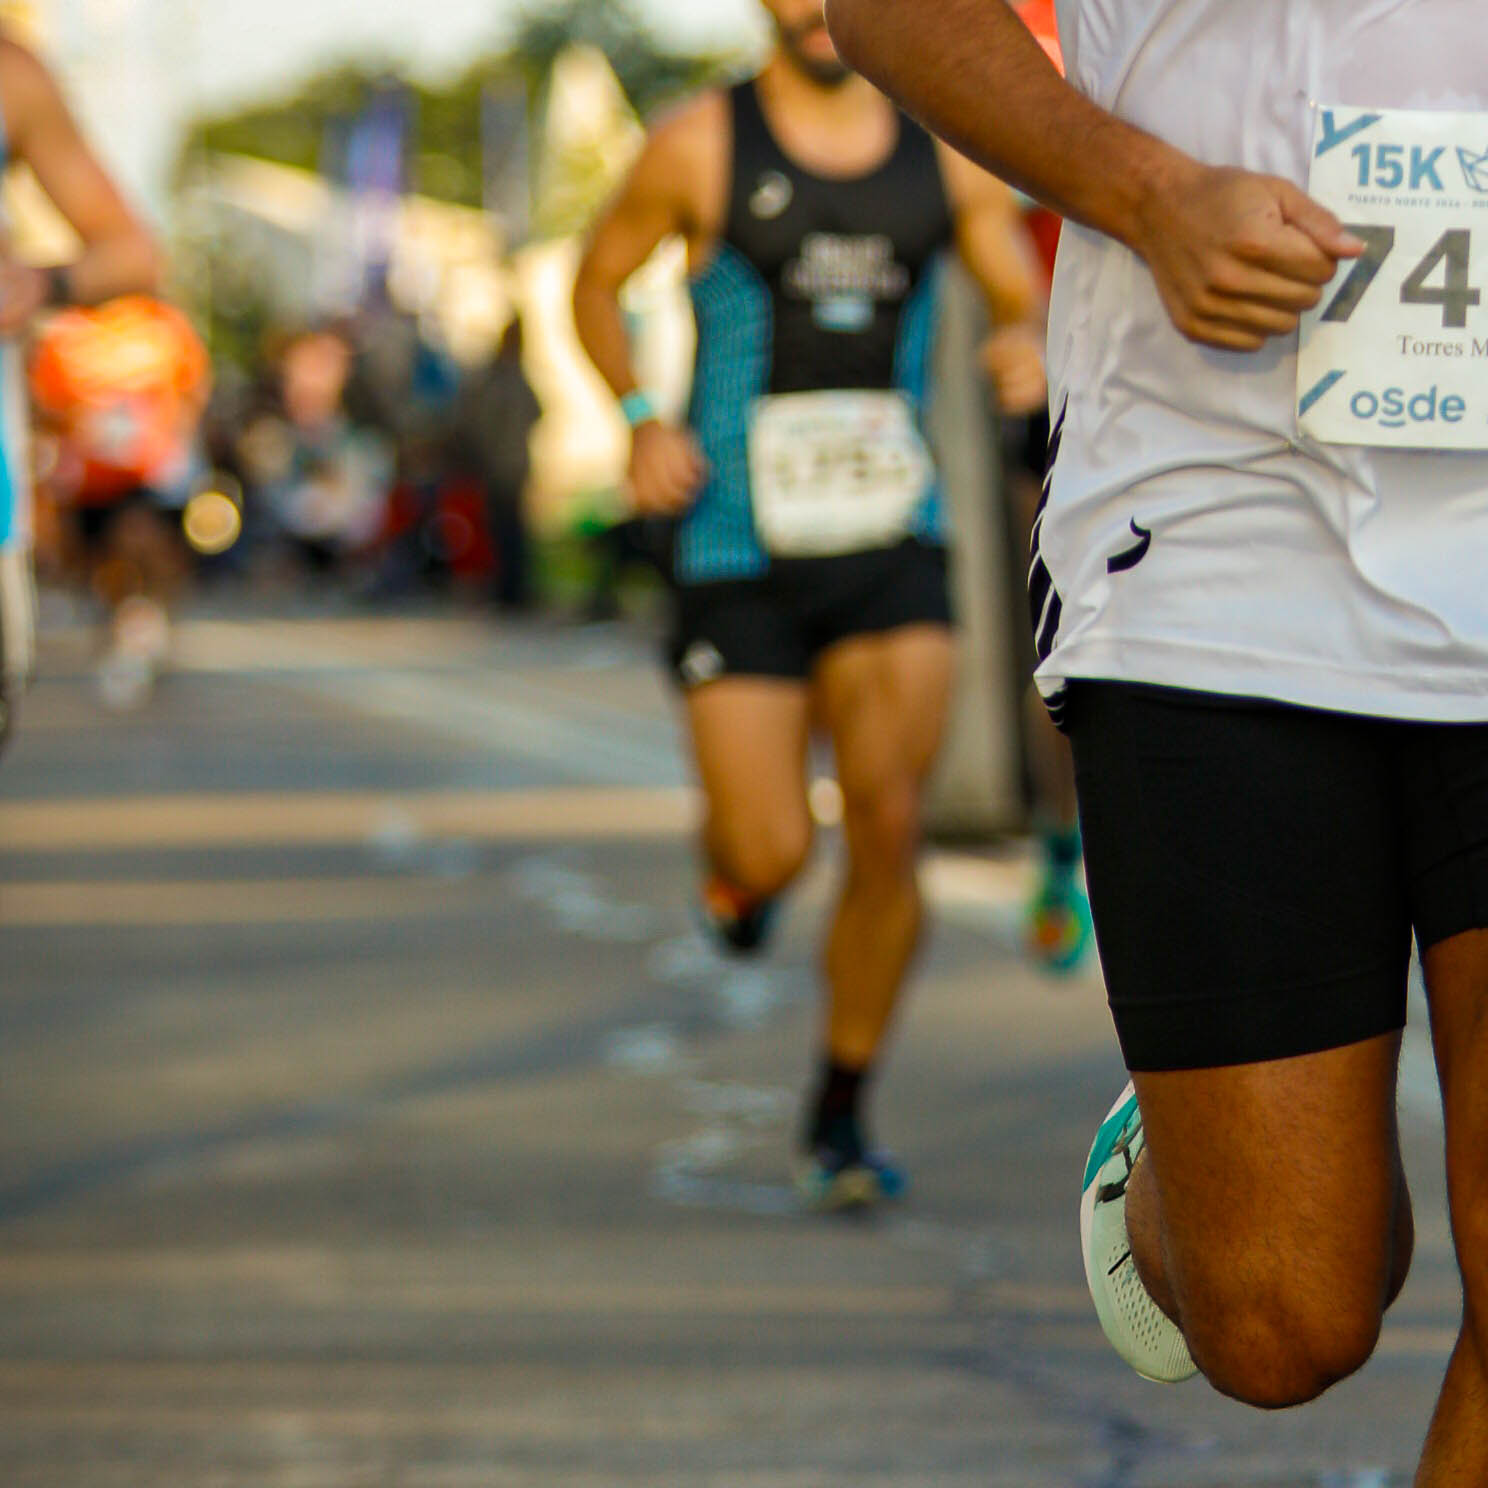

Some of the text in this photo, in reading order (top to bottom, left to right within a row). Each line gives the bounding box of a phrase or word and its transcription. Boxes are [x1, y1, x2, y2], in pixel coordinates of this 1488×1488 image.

[1351, 143, 1447, 191] 15K
[1397, 335, 1463, 357] Torres
[1350, 385, 1466, 424] osde
